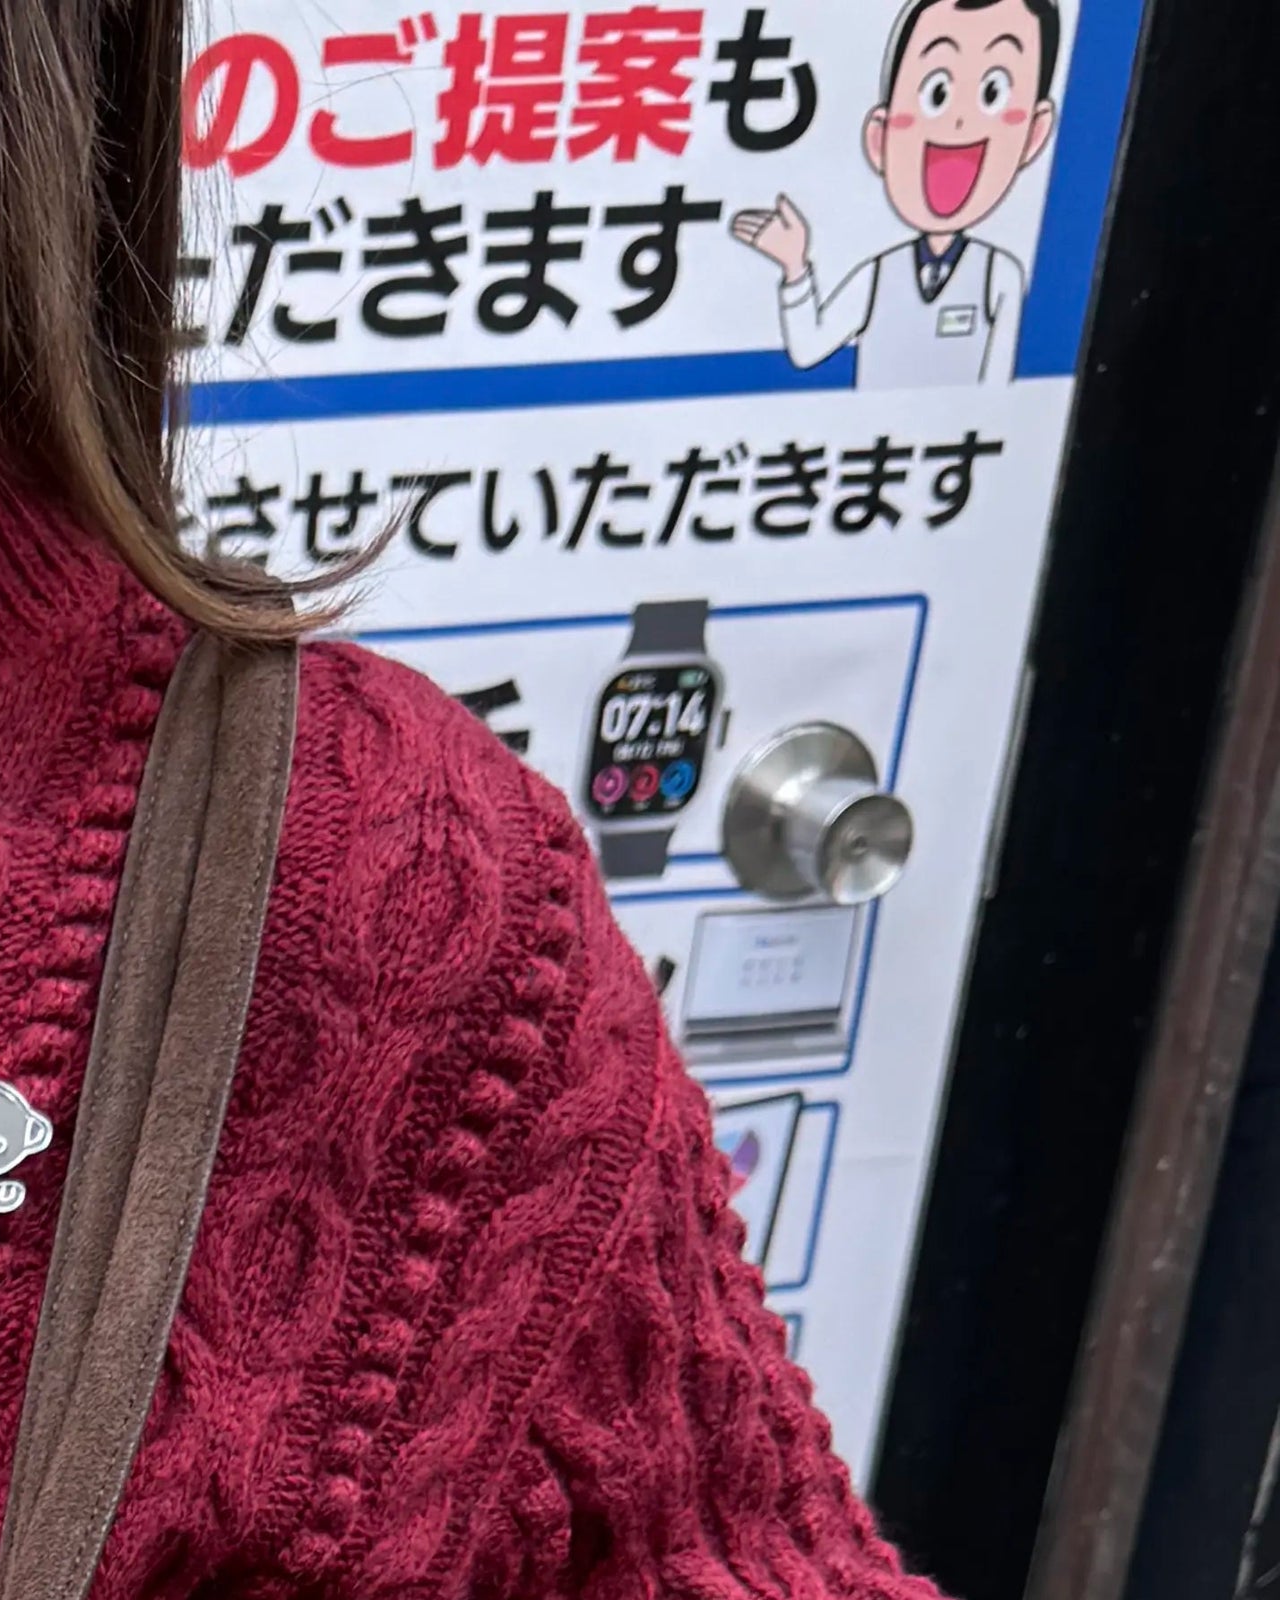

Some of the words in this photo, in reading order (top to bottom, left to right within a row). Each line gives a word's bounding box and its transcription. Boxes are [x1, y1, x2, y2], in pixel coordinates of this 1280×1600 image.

[181, 6, 818, 178] のご提案も
[178, 431, 1003, 566] させていただきます
[601, 690, 706, 742] 07:14
